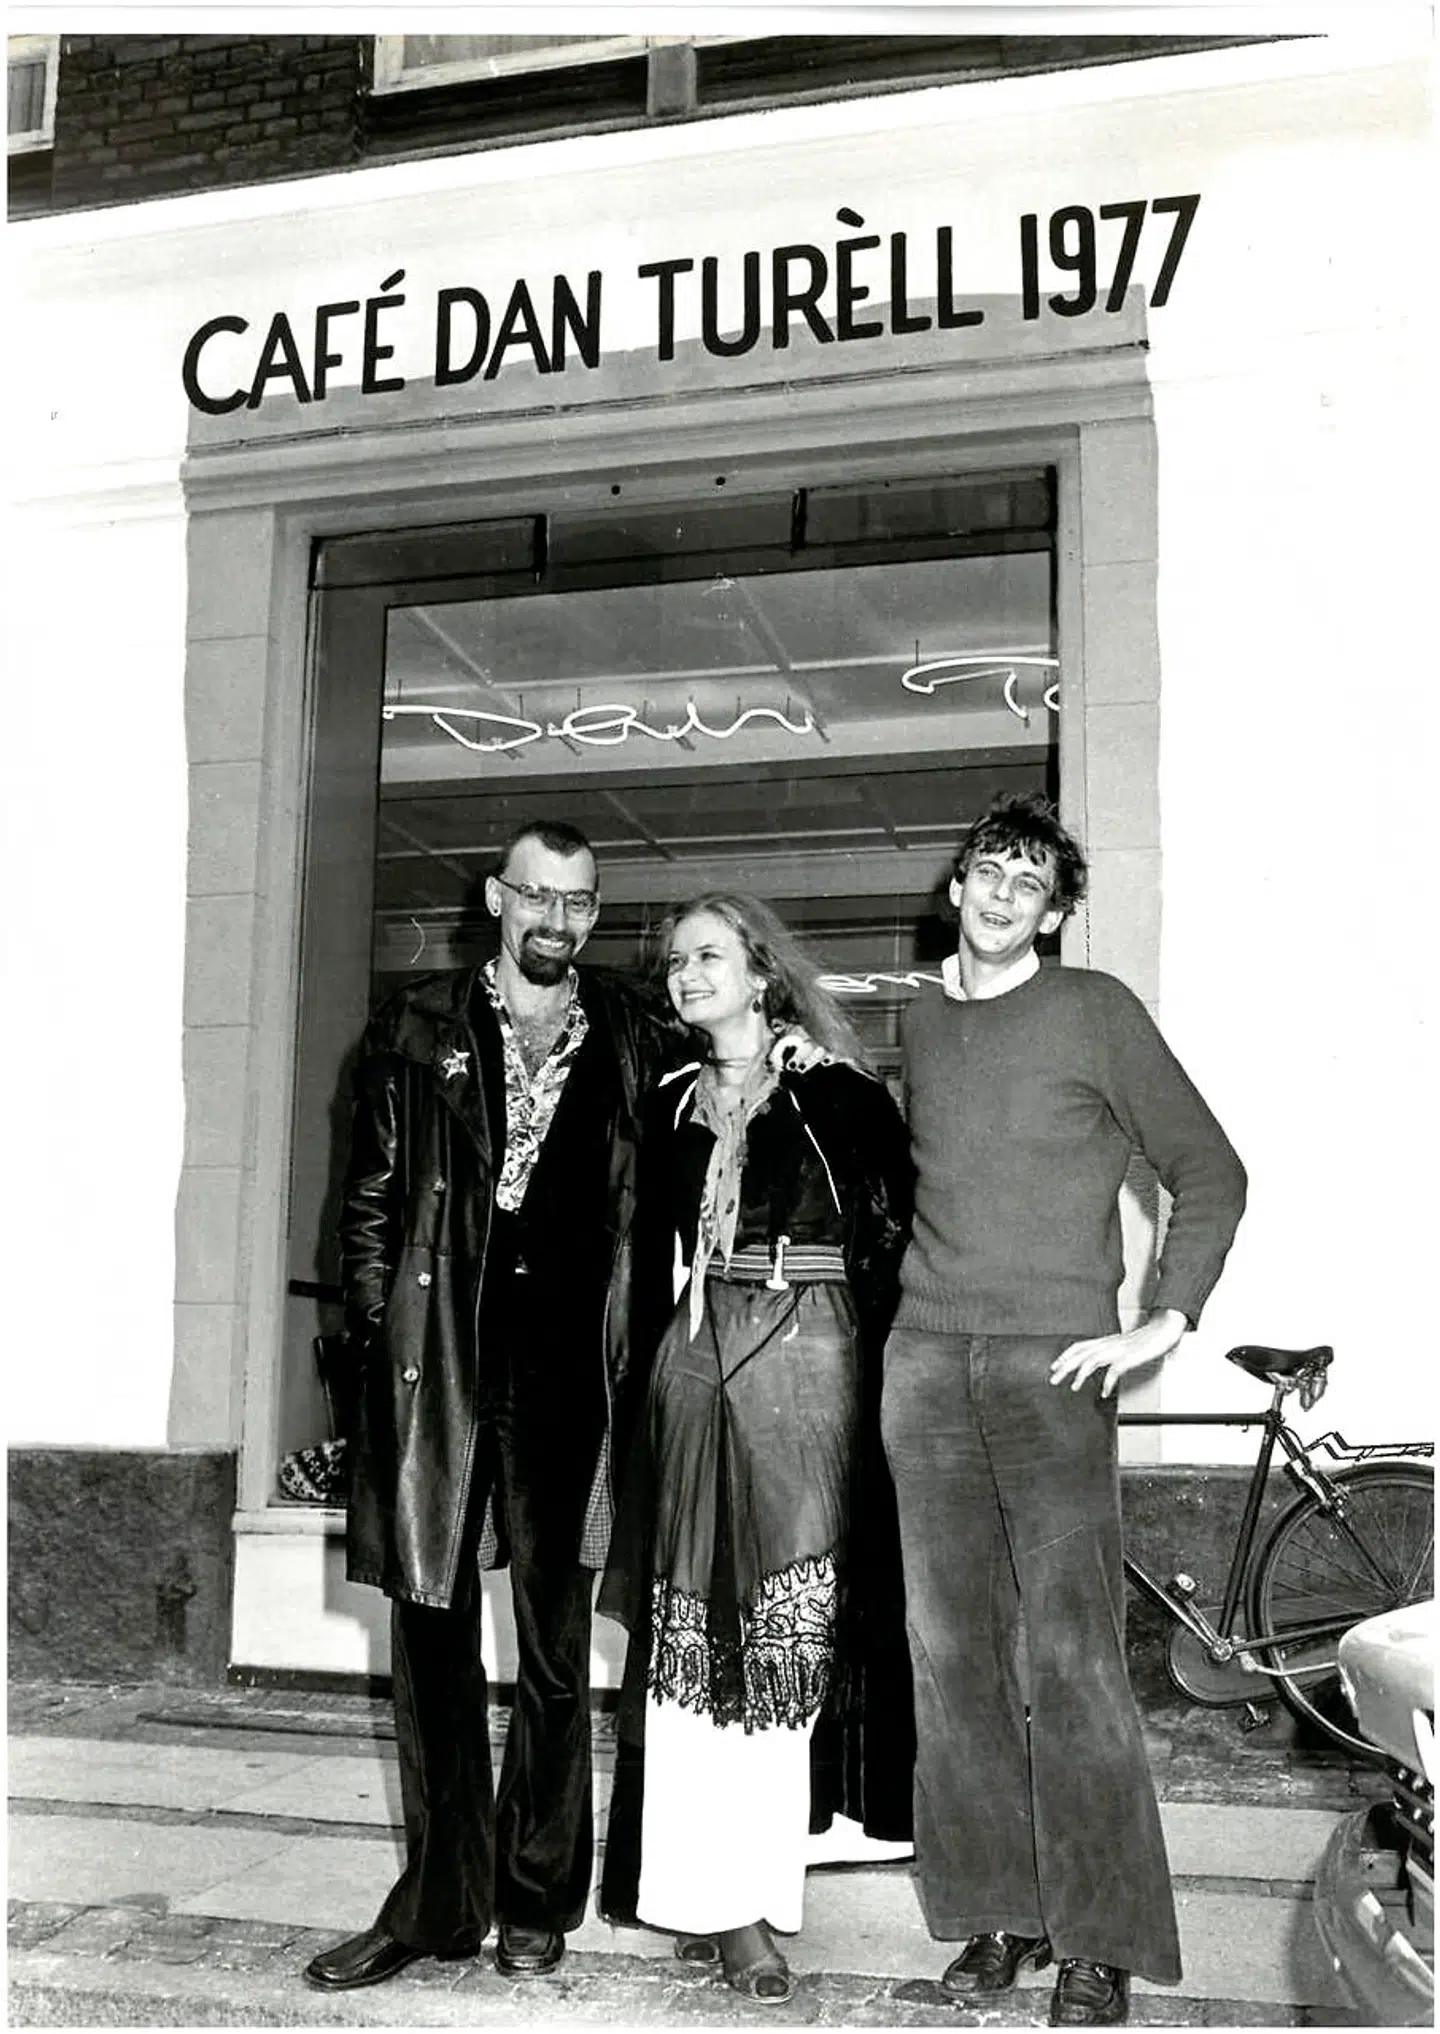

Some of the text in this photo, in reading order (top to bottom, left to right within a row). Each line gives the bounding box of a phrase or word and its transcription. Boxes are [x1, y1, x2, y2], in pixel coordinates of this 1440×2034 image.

[181, 193, 1202, 417] CAFÉ DAN TURÈLL 1977
[382, 701, 817, 751] Dan
